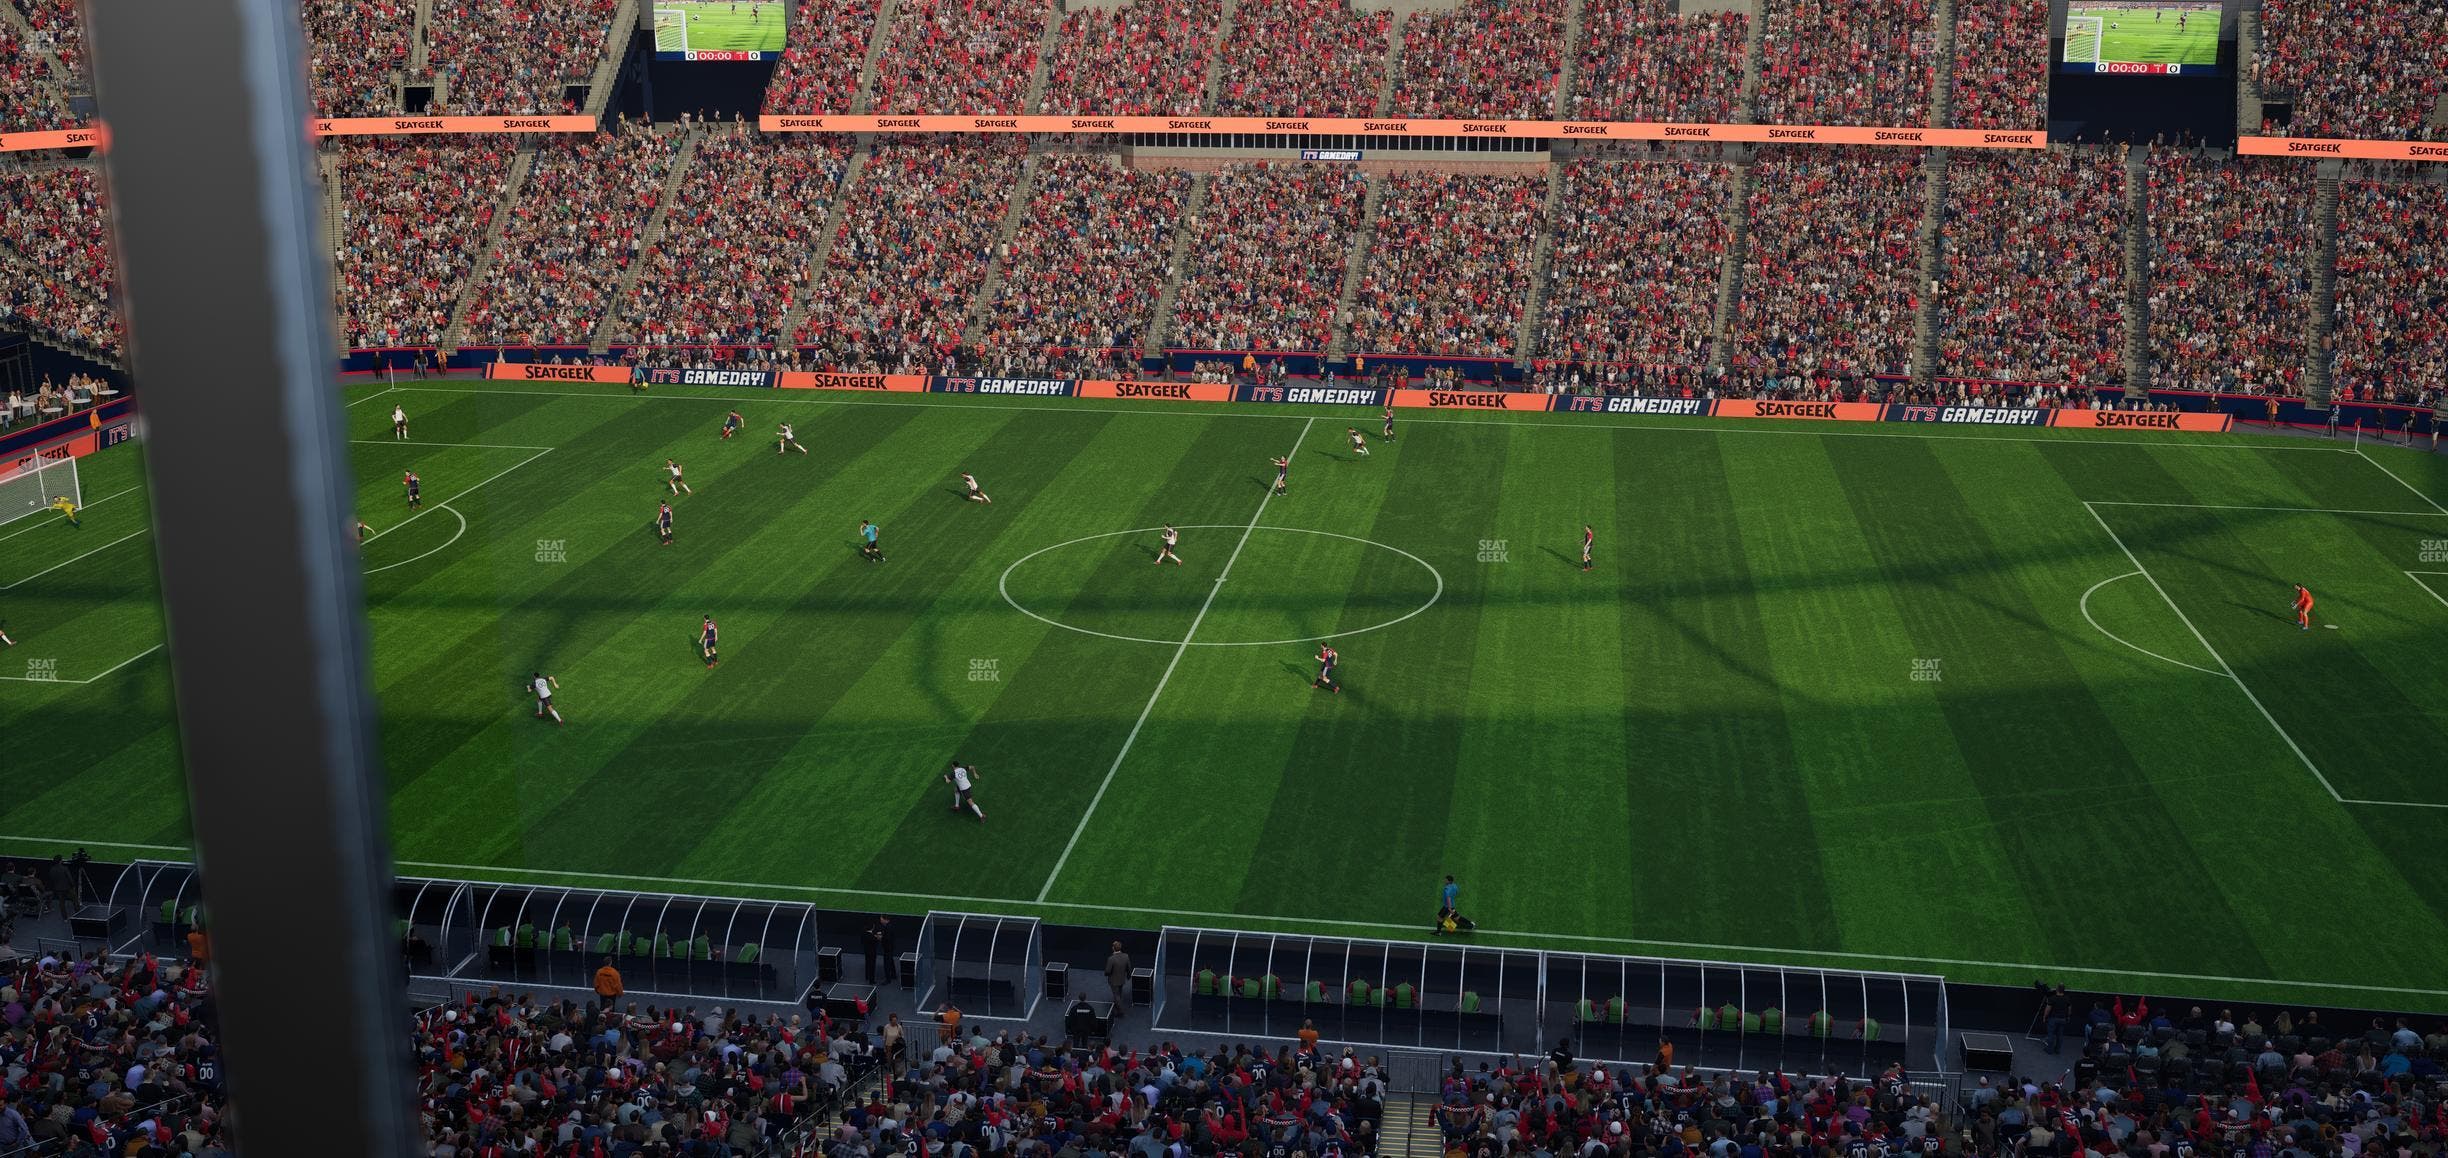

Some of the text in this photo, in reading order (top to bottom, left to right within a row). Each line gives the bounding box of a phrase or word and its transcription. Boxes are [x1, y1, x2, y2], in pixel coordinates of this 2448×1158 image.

[700, 52, 732, 60] 00:00
[2111, 64, 2147, 73] 00:00
[394, 120, 444, 130] SEATGEEK
[503, 119, 551, 129] SEATGEEK
[779, 118, 823, 128] SEATGEEK
[877, 118, 921, 128] SEATGEEK
[974, 119, 1018, 129] SEATGEEK
[1071, 119, 1115, 129] SEATGEEK
[1168, 120, 1212, 130] SEATGEEK
[1265, 121, 1309, 131] SEATGEEK
[1363, 122, 1407, 132] SEATGEEK
[1462, 123, 1507, 134] SEATGEEK
[1562, 125, 1608, 135] SEATGEEK
[1664, 126, 1711, 137] SEATGEEK
[1768, 128, 1815, 139] SEATGEEK
[1874, 131, 1923, 142] SEATGEEK
[1983, 133, 2033, 145] SEATGEEK
[2288, 141, 2342, 154] SEATGEEK
[2409, 145, 2448, 156] SEATGE
[525, 366, 595, 381] SEATGEEK
[651, 369, 766, 386] IT'S GAMEDAY!
[815, 374, 887, 389] SEATGEEK
[945, 378, 1065, 395] IT'S GAMEDAY!
[1116, 383, 1191, 399] SEATGEEK
[1252, 387, 1376, 404] IT'S GAMEDAY!
[1429, 392, 1507, 408] SEATGEEK
[1570, 397, 1700, 414] IT'S GAMEDAY!
[1755, 402, 1837, 418] SEATGEEK
[1902, 406, 2038, 424] IT'S GAMEDAY!
[2096, 412, 2181, 429] SEATGEEK
[108, 424, 128, 446] IT'S
[200, 1068, 213, 1080] 00
